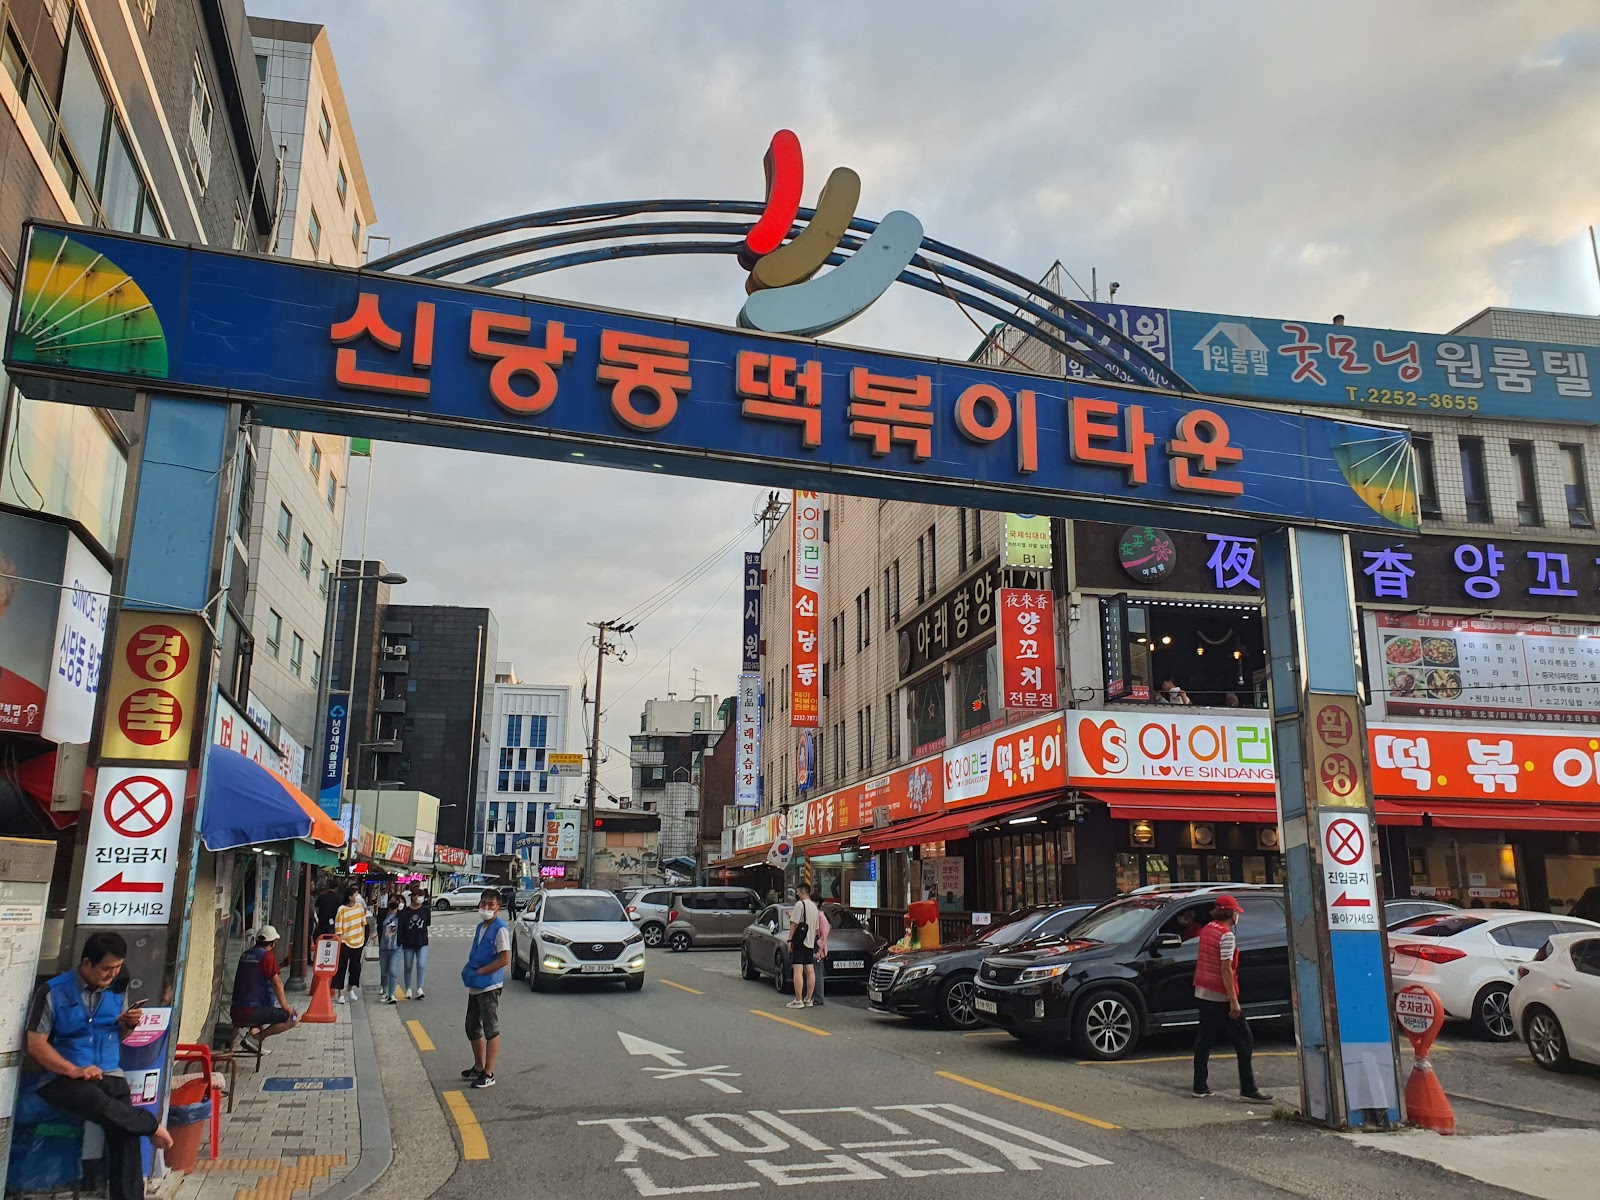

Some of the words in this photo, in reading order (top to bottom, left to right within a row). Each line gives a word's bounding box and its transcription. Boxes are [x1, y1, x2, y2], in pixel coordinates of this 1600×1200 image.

[1210, 345, 1270, 376] 원룸텔
[1280, 323, 1423, 387] 굿모닝
[1436, 342, 1593, 398] 원룸텔
[331, 293, 692, 431] 신당동
[735, 349, 1038, 474] 떡볶이
[1068, 396, 1244, 497] 타운
[1345, 386, 1479, 411] T.2252-3655
[803, 507, 820, 580] 아이러브
[1023, 554, 1036, 564] B1
[72, 579, 97, 623] SINCE
[745, 568, 760, 660] 고시원
[59, 624, 86, 688] 신당동
[795, 594, 818, 686] 신당동
[1016, 611, 1042, 691] 양꼬치
[127, 634, 181, 740] 경축
[1009, 692, 1053, 708] 전문점
[327, 719, 341, 777] MG새마을금고
[742, 713, 755, 786] 노래연습장
[954, 750, 988, 780] 아이러브
[996, 735, 1061, 788] 떡볶이
[1321, 709, 1352, 790] 환영
[1374, 734, 1600, 794] 떡볶이
[808, 796, 835, 836] 신당동
[94, 846, 168, 865] 진입금지
[1327, 871, 1370, 886] 진입금지
[86, 901, 165, 917] 돌아가세요
[1330, 912, 1376, 925] 돌아가세요
